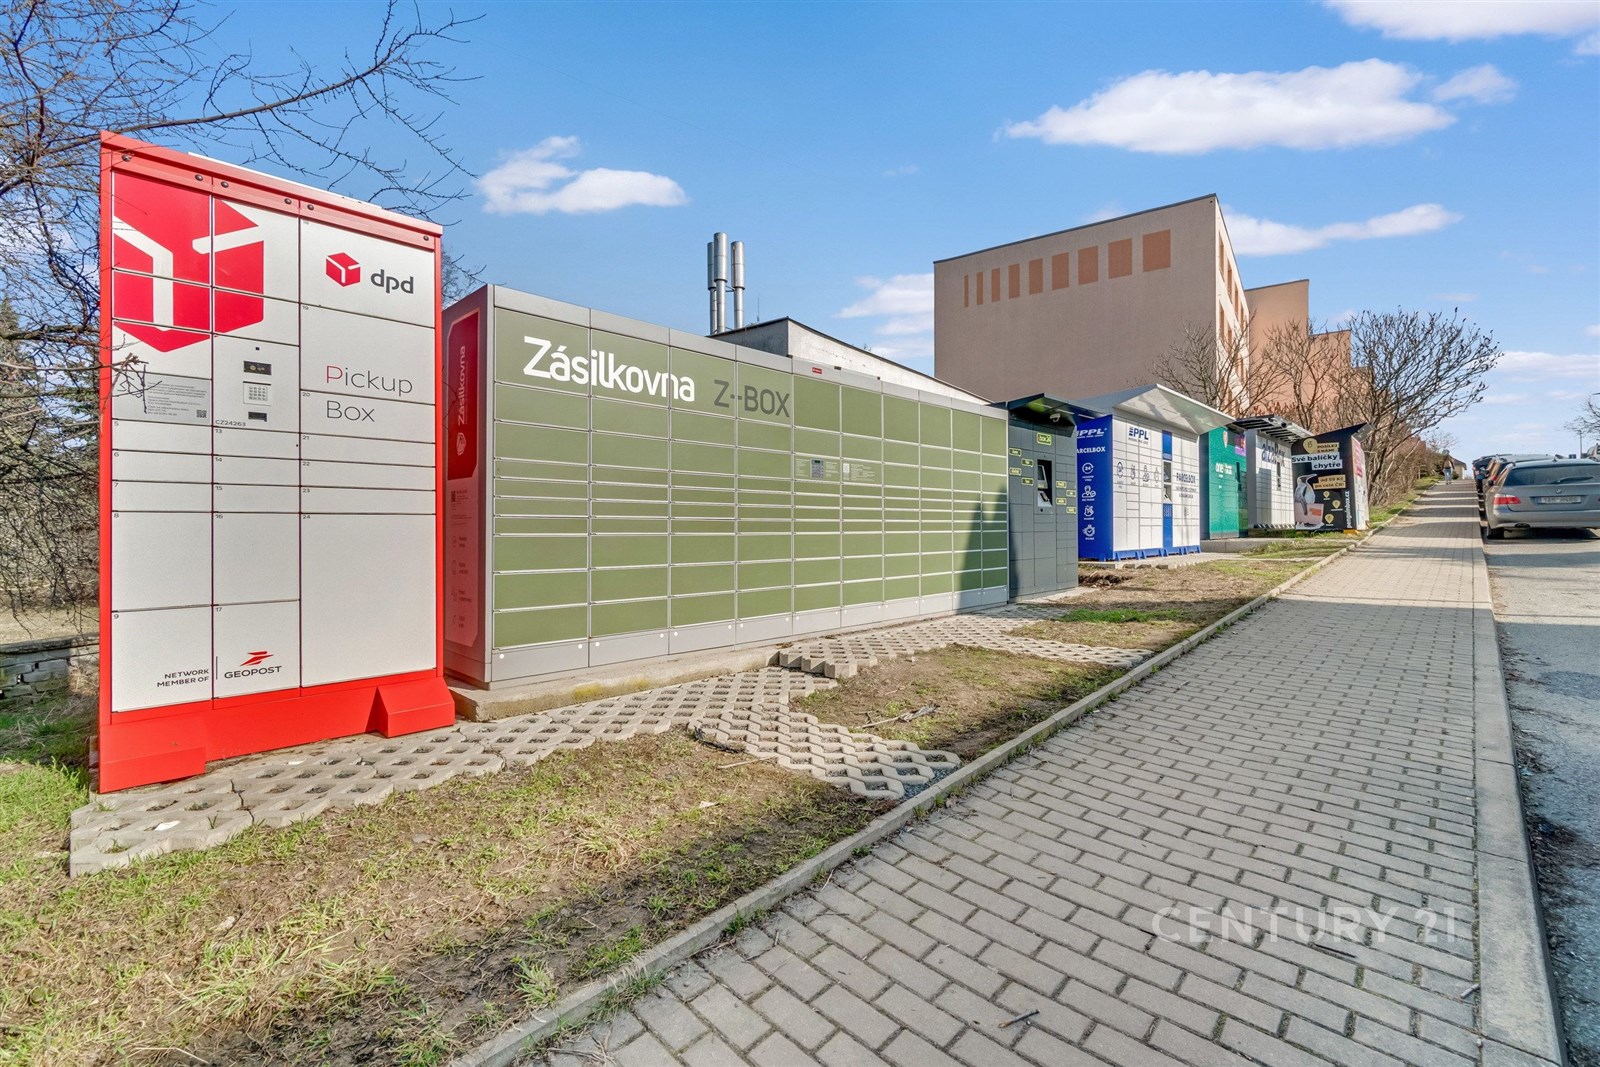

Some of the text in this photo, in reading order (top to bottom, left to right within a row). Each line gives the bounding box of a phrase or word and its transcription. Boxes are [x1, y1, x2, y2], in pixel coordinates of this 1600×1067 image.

[370, 268, 414, 294] dpd
[523, 335, 695, 402] Zásilkovna
[326, 365, 413, 397] Pickup
[458, 345, 466, 426] Zásilkovna
[326, 400, 375, 423] Box
[1079, 428, 1105, 436] PPL
[1134, 428, 1149, 440] PPL
[1077, 446, 1105, 454] ARCELBOX
[164, 668, 209, 679] NETWORK
[224, 666, 282, 679] GEOPOST
[157, 678, 195, 688] MEMBER
